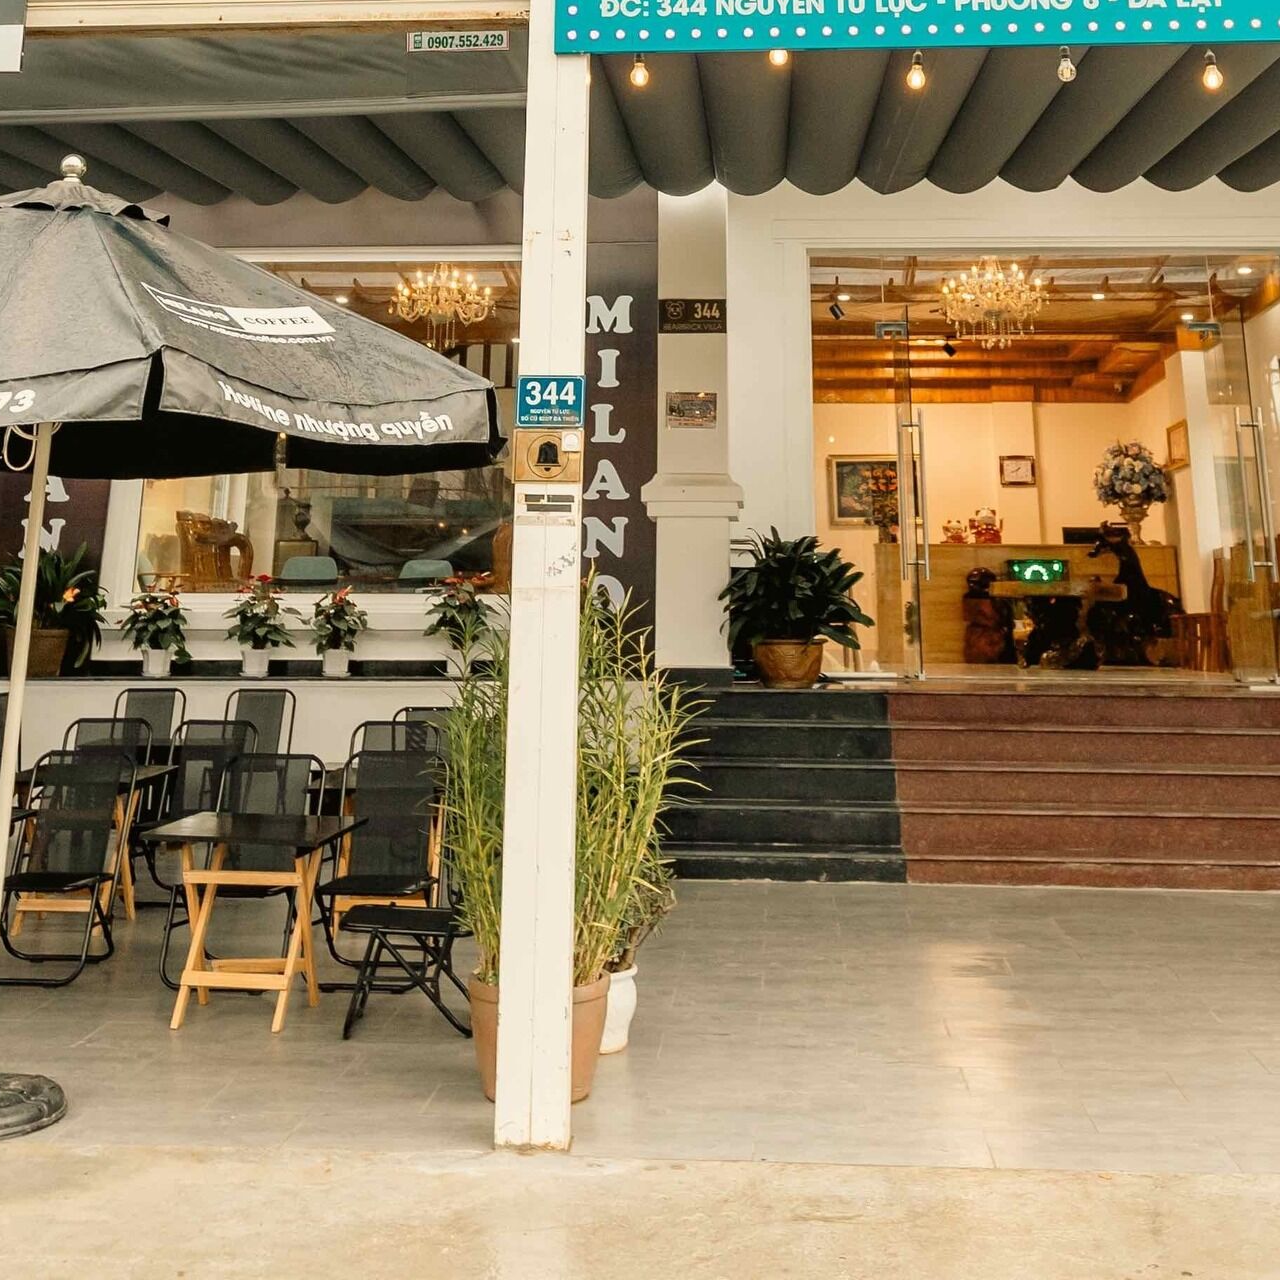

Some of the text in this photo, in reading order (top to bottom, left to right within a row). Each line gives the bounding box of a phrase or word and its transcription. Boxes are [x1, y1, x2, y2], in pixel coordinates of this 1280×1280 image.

[427, 34, 504, 49] 0907.552.429
[694, 303, 720, 319] 344
[243, 316, 315, 326] COFFEE
[525, 381, 576, 405] 344
